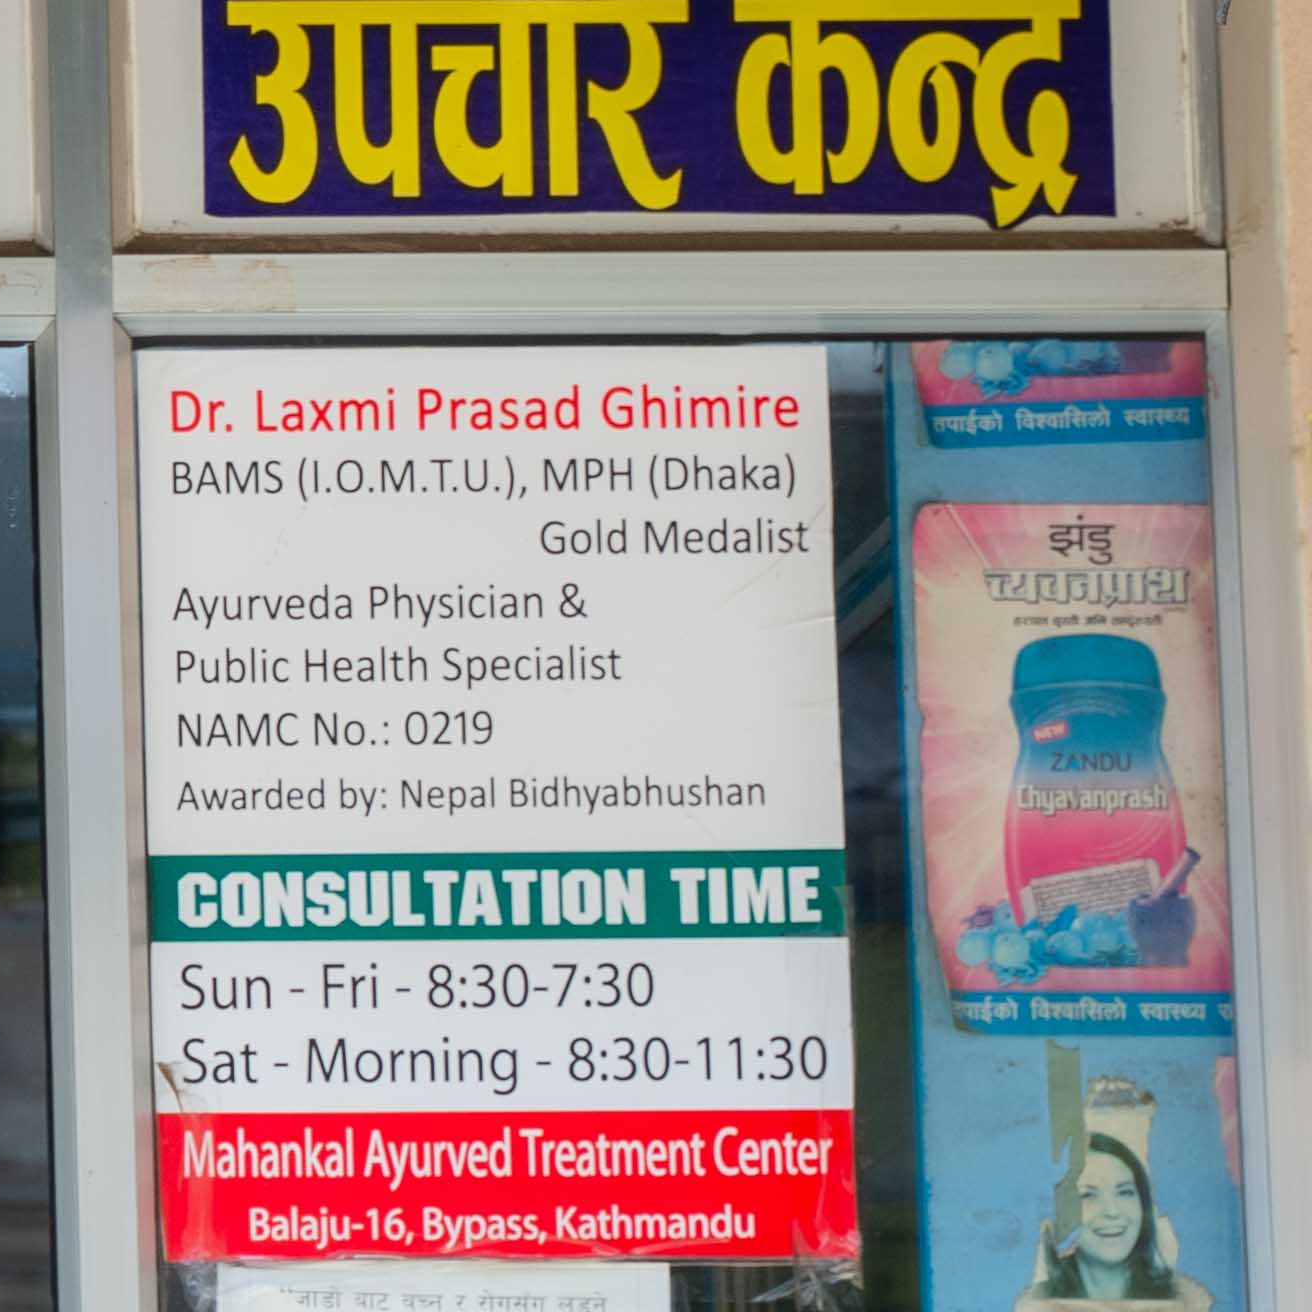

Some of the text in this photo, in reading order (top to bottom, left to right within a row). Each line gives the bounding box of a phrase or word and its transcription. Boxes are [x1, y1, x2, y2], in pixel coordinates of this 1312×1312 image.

[170, 383, 801, 433] Dr. Laxmi Prasad Ghimire
[171, 453, 797, 500] BAMS (I.O.M.T.U.), MPH (Dhaka)
[540, 518, 810, 556] Gold Medalist
[1048, 514, 1115, 565] झंडु
[172, 582, 589, 629] Ayurveda Physician &
[177, 645, 622, 690] Public Health Specialist
[177, 712, 495, 748] NAMC No.: 0219
[1050, 752, 1132, 773] ZANDU
[177, 775, 767, 816] Awarded by: Nepal Bidhyabhushan
[1017, 784, 1170, 817] Chyavanprash
[177, 865, 823, 928] CONSULTATION TIME
[180, 963, 272, 1012] Sun
[322, 962, 378, 1010] Fri
[428, 962, 655, 1010] 8:30-7:30
[182, 1038, 258, 1086] Sat
[306, 1036, 519, 1095] Morning
[568, 1035, 828, 1083] 8:30-11:30
[182, 1126, 833, 1190] Mahankal Ayurved Treatment Center
[248, 1203, 756, 1250] Balaju-16, Bypass, Kathmandu
